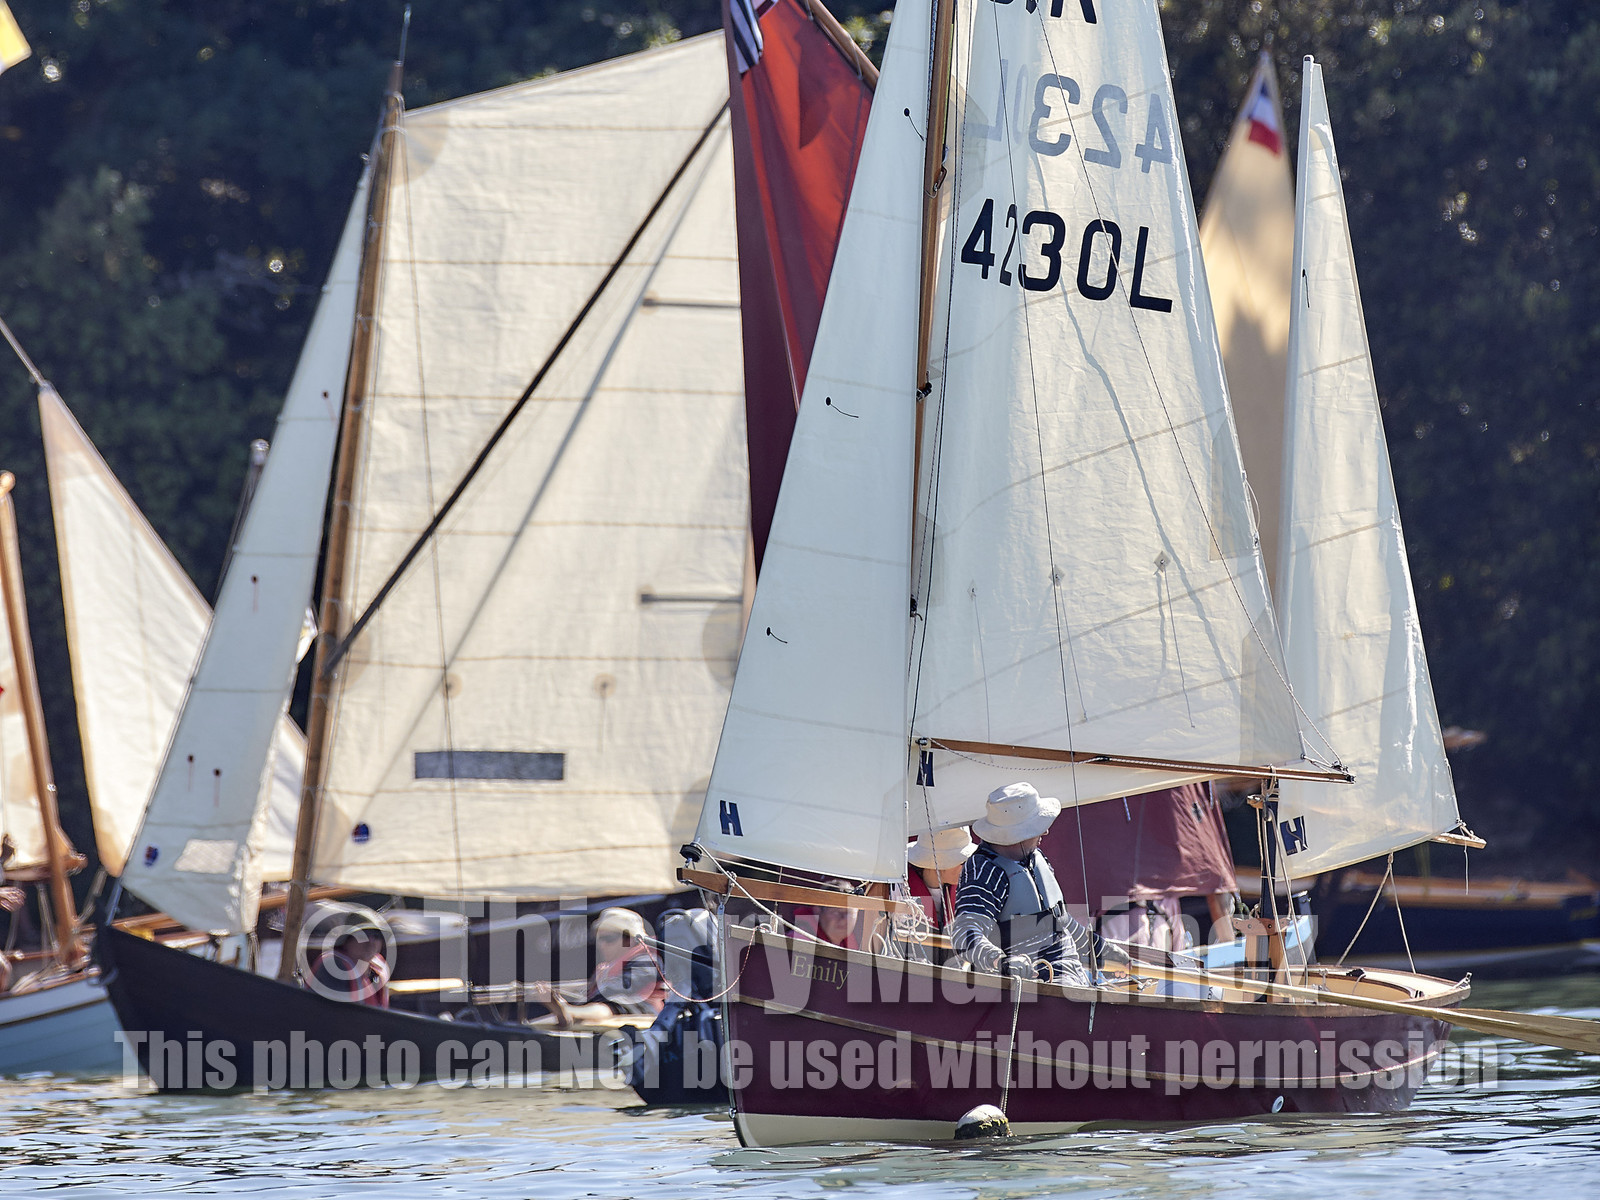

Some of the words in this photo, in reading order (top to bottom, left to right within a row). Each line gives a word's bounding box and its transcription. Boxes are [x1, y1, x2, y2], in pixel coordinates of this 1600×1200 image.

[719, 799, 744, 837] H
[1279, 815, 1308, 856] H
[791, 955, 850, 990] Emily
